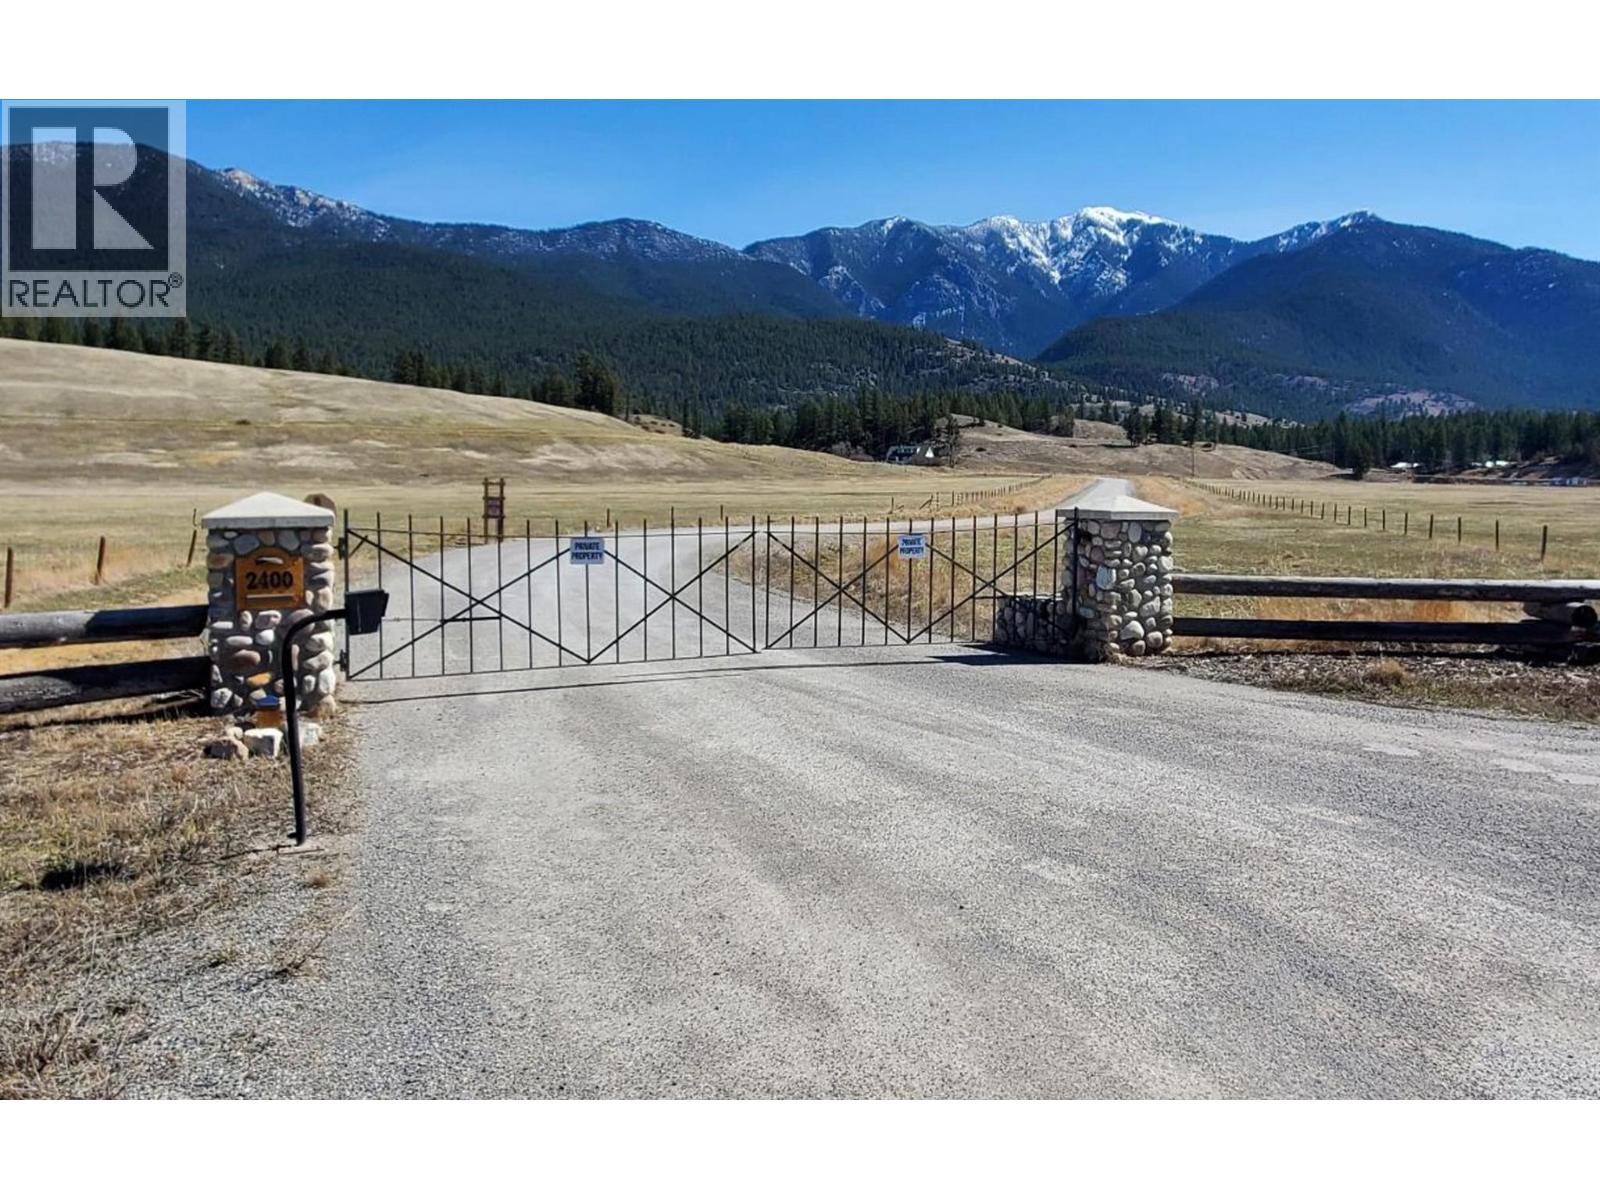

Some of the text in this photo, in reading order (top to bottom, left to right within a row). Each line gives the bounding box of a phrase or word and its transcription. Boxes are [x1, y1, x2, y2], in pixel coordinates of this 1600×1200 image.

[574, 542, 600, 550] PRIVATE
[571, 551, 603, 560] PROPERTY
[245, 570, 294, 590] 2400
